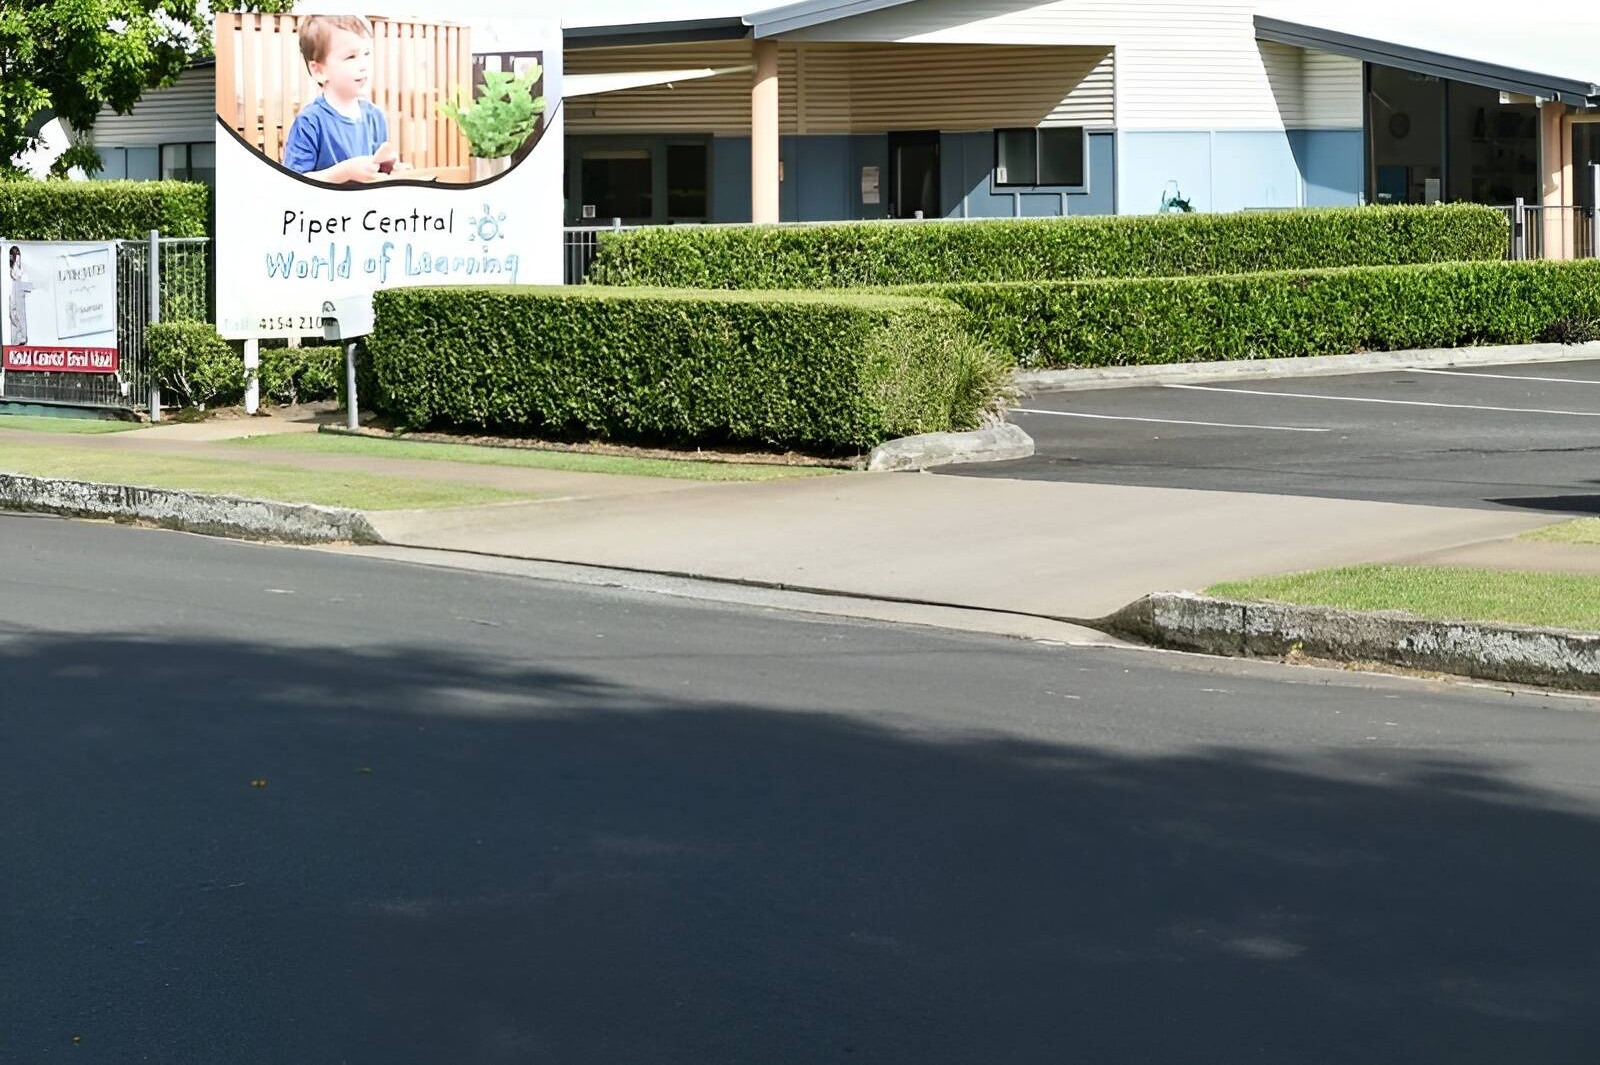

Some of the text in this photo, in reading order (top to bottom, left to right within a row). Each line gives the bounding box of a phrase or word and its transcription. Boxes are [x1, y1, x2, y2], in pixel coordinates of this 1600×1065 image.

[282, 208, 454, 243] Piper Central
[266, 241, 519, 285] World of Learning
[299, 316, 325, 330] 210
